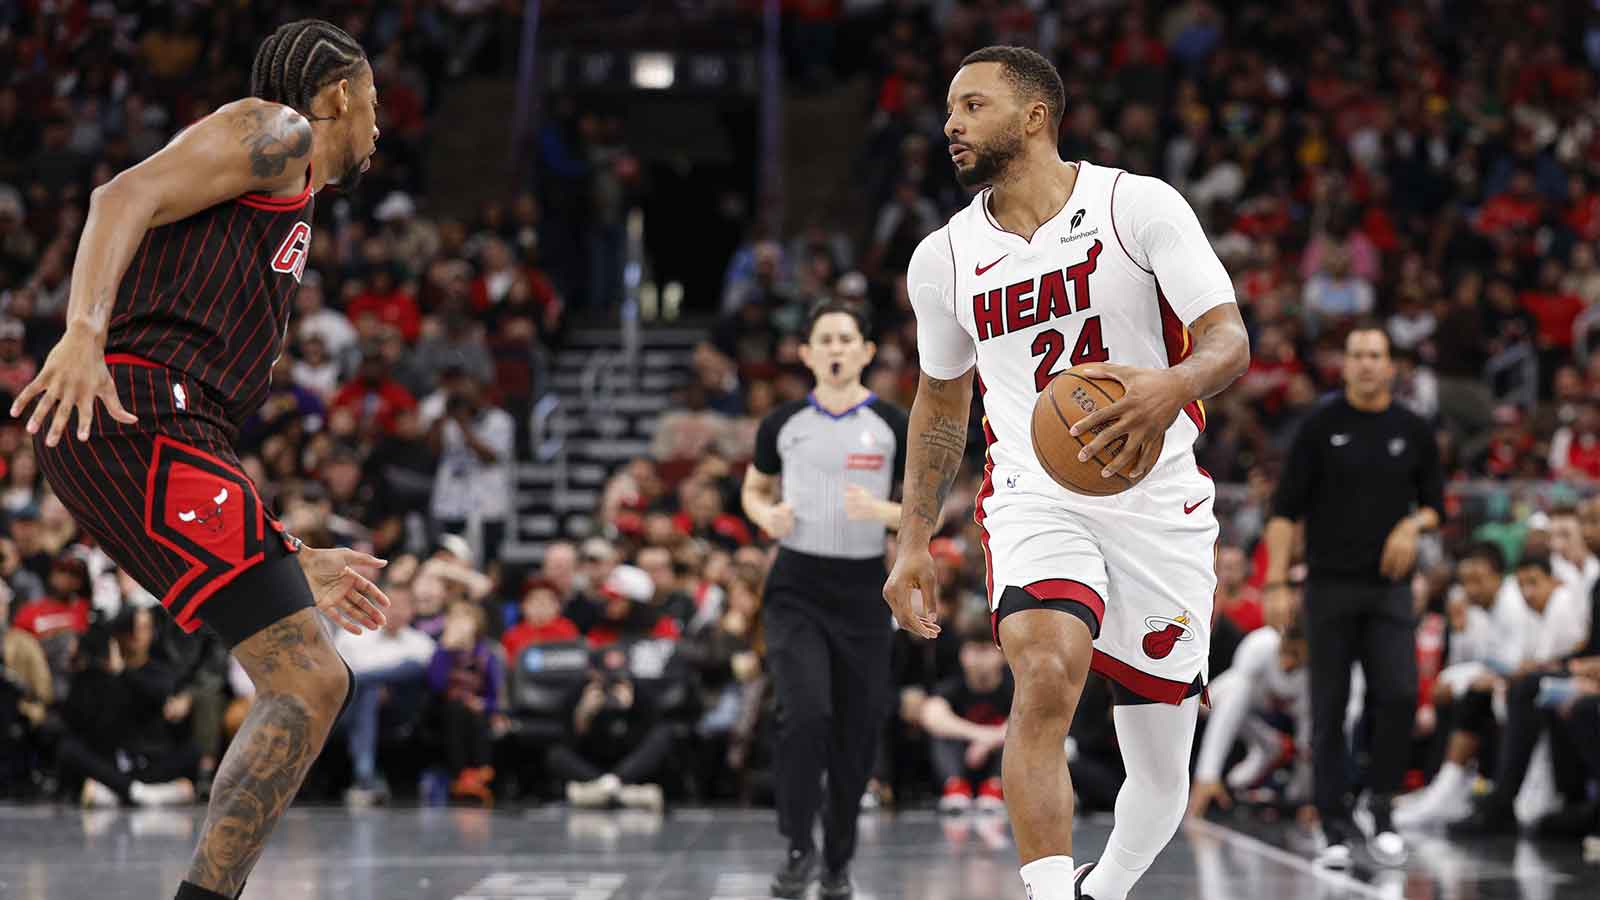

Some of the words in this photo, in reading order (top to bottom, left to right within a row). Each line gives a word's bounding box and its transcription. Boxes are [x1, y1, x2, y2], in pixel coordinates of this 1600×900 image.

[1060, 228, 1099, 244] Robinhood
[973, 240, 1103, 342] HEAT
[1031, 316, 1109, 392] 24
